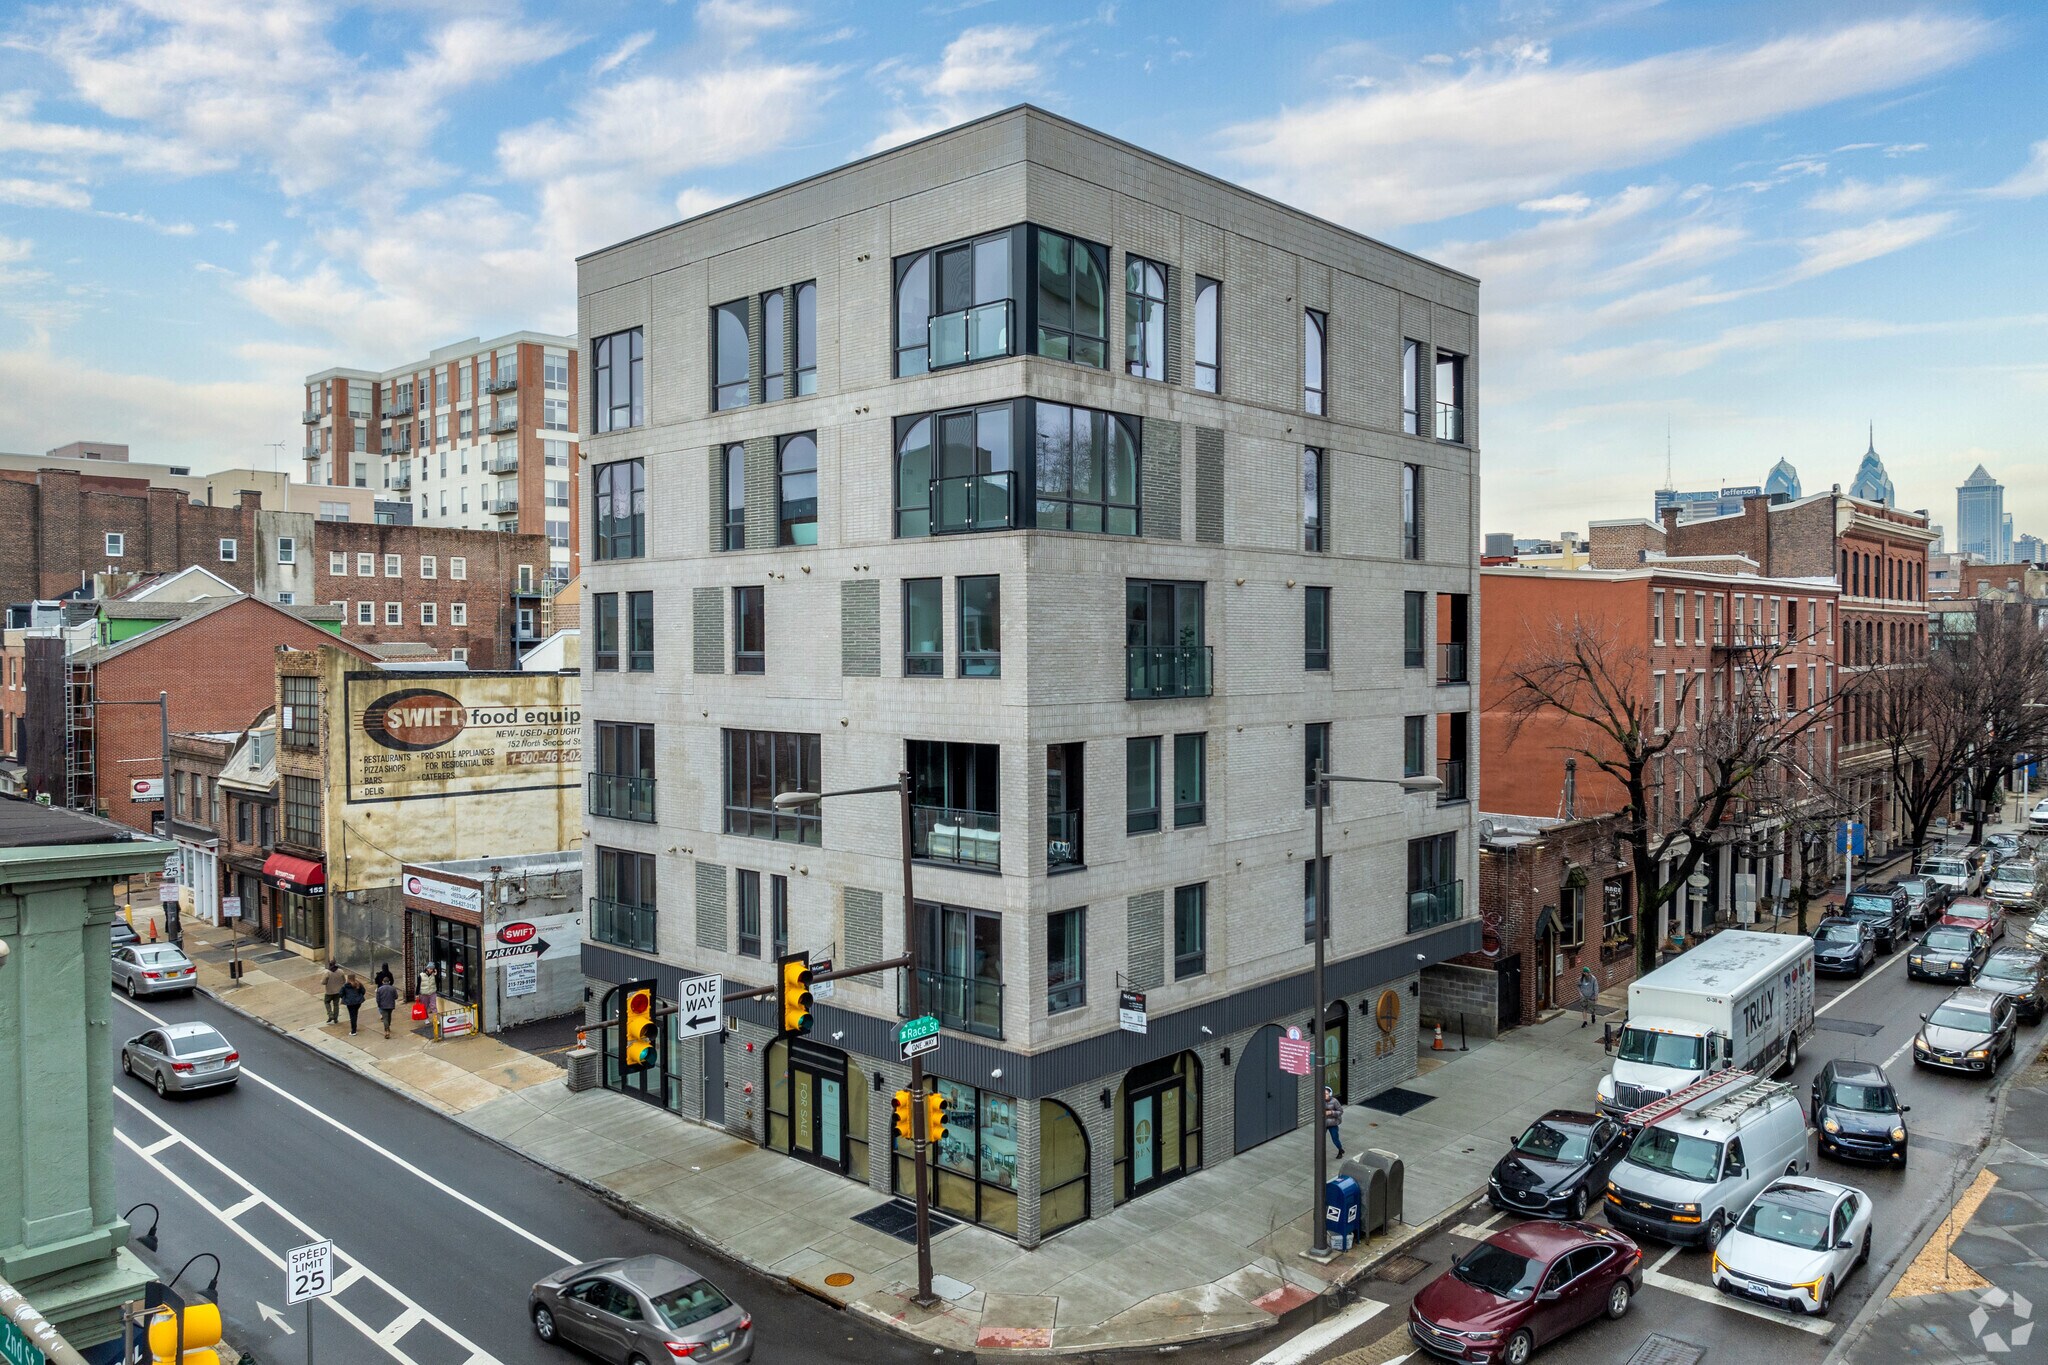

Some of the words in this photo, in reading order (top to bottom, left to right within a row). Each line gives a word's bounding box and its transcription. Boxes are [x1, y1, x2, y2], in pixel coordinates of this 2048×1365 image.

[1722, 488, 1757, 496] Jefferson
[387, 707, 463, 729] SWIFT
[471, 708, 518, 725] food
[524, 707, 581, 726] equip
[521, 740, 540, 748] North
[542, 738, 570, 746] Second
[364, 754, 411, 764] RESTAURANTS
[420, 751, 456, 760] PRO-STYLE
[458, 748, 495, 758] APPLIANCES
[364, 766, 384, 774] PIZZA
[384, 764, 406, 772] SHOPS
[426, 762, 438, 770] FOR
[442, 760, 481, 769] RESIDENTIAL
[482, 758, 494, 767] USE
[364, 776, 382, 784] BARS
[421, 772, 456, 781] CATERERS
[364, 787, 384, 796] DELIS
[166, 866, 178, 876] 25
[506, 927, 534, 938] SWIFT
[486, 944, 532, 960] PARKING
[686, 980, 716, 996] ONE
[686, 995, 715, 1012] WAY
[1744, 987, 1774, 1038] TRULY
[908, 1026, 927, 1039] Race
[930, 1022, 938, 1032] St
[912, 1041, 922, 1052] ONE
[800, 1082, 808, 1107] FOR
[800, 1108, 808, 1137] SALE
[292, 1247, 328, 1264] SPEED
[296, 1258, 324, 1273] LIMIT
[296, 1270, 324, 1296] 25
[5, 1324, 22, 1364] 2nd
